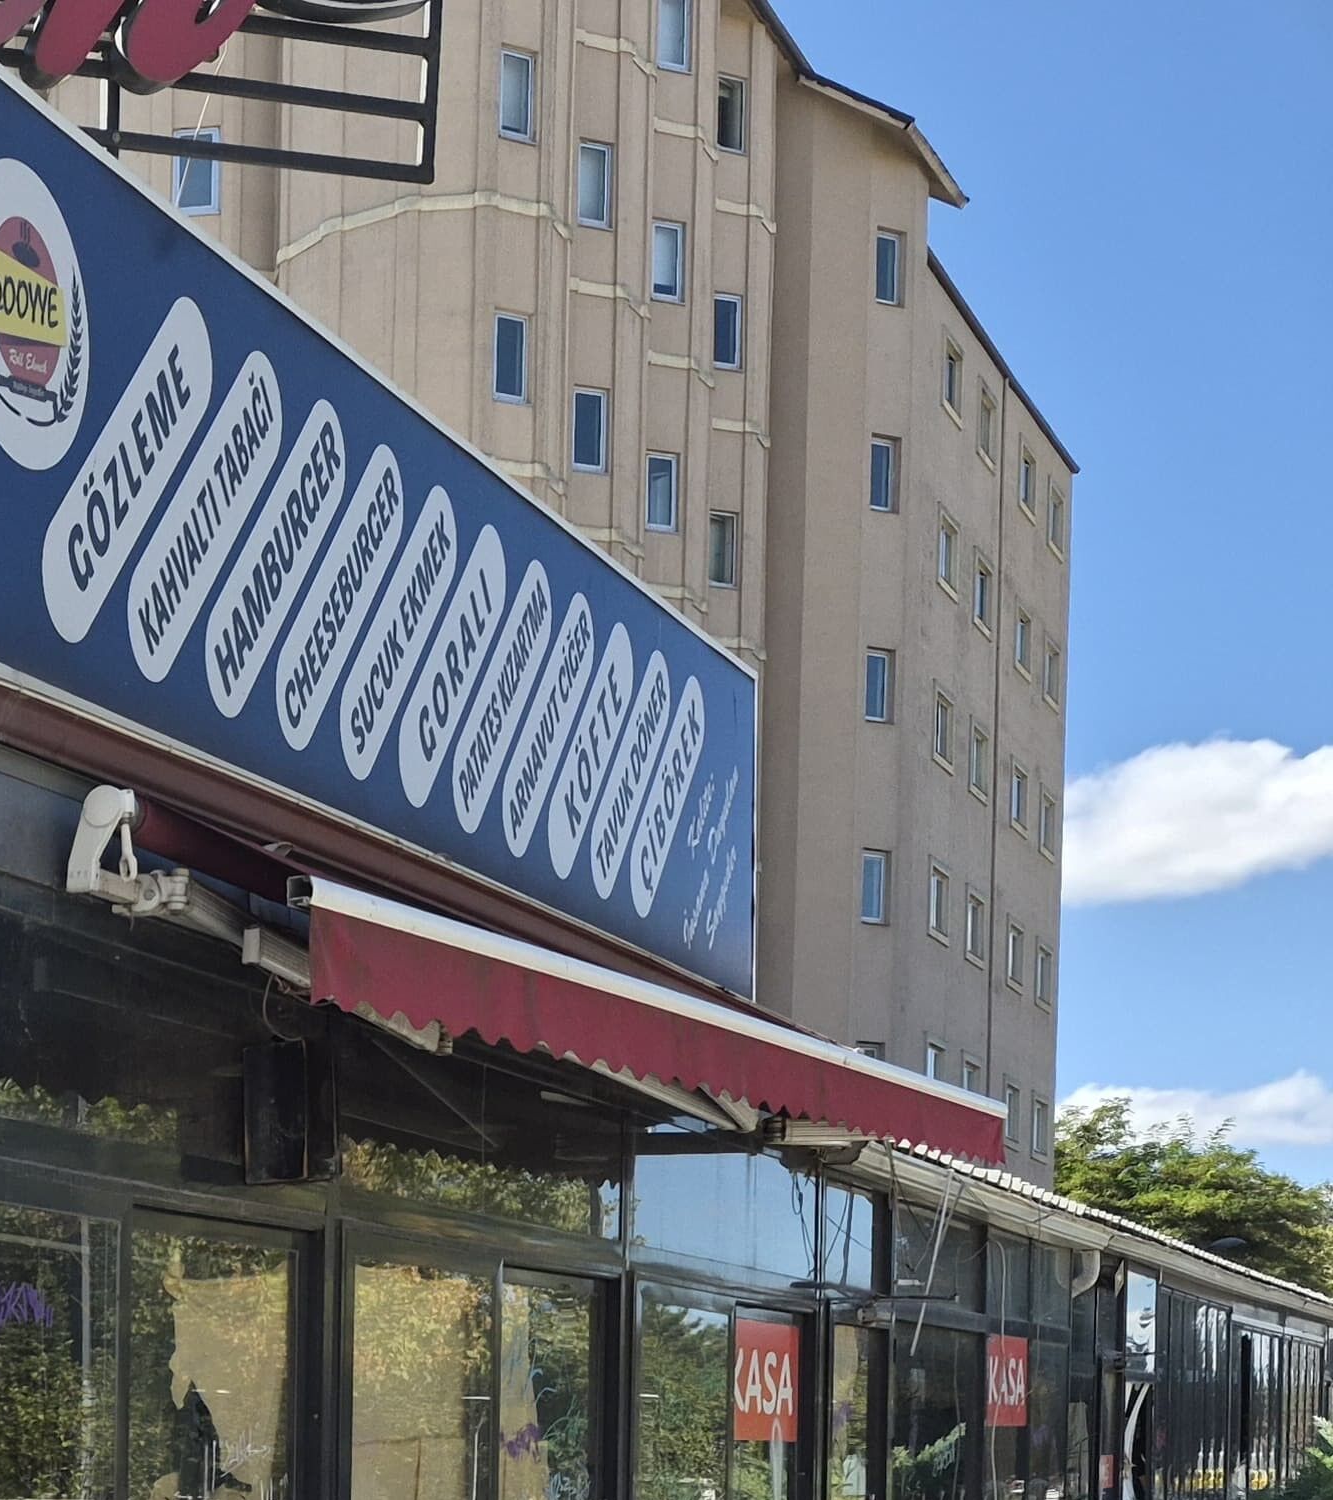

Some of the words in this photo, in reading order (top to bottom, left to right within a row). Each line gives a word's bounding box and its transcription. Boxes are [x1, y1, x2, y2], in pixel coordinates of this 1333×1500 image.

[67, 343, 193, 593] GÖZLEME
[138, 478, 222, 657] KAHVALTI
[213, 371, 274, 508] TABAĞI
[214, 420, 341, 698] HAMBURGER
[284, 465, 400, 730] CHEESEBURGER
[350, 619, 405, 756] SUCUK
[398, 510, 452, 643] EKMEK
[418, 567, 492, 763] GORALI
[458, 692, 503, 814] PATATES
[497, 578, 549, 717] KIZARTMA
[508, 685, 561, 841] ARNAVUT
[558, 608, 592, 704] CİĞER
[564, 662, 623, 839] KÖFTE
[595, 767, 634, 879] TAVUK
[630, 669, 668, 785] DÖNER
[640, 698, 701, 897] ÇİBÖREK
[988, 1355, 1025, 1407] KASA
